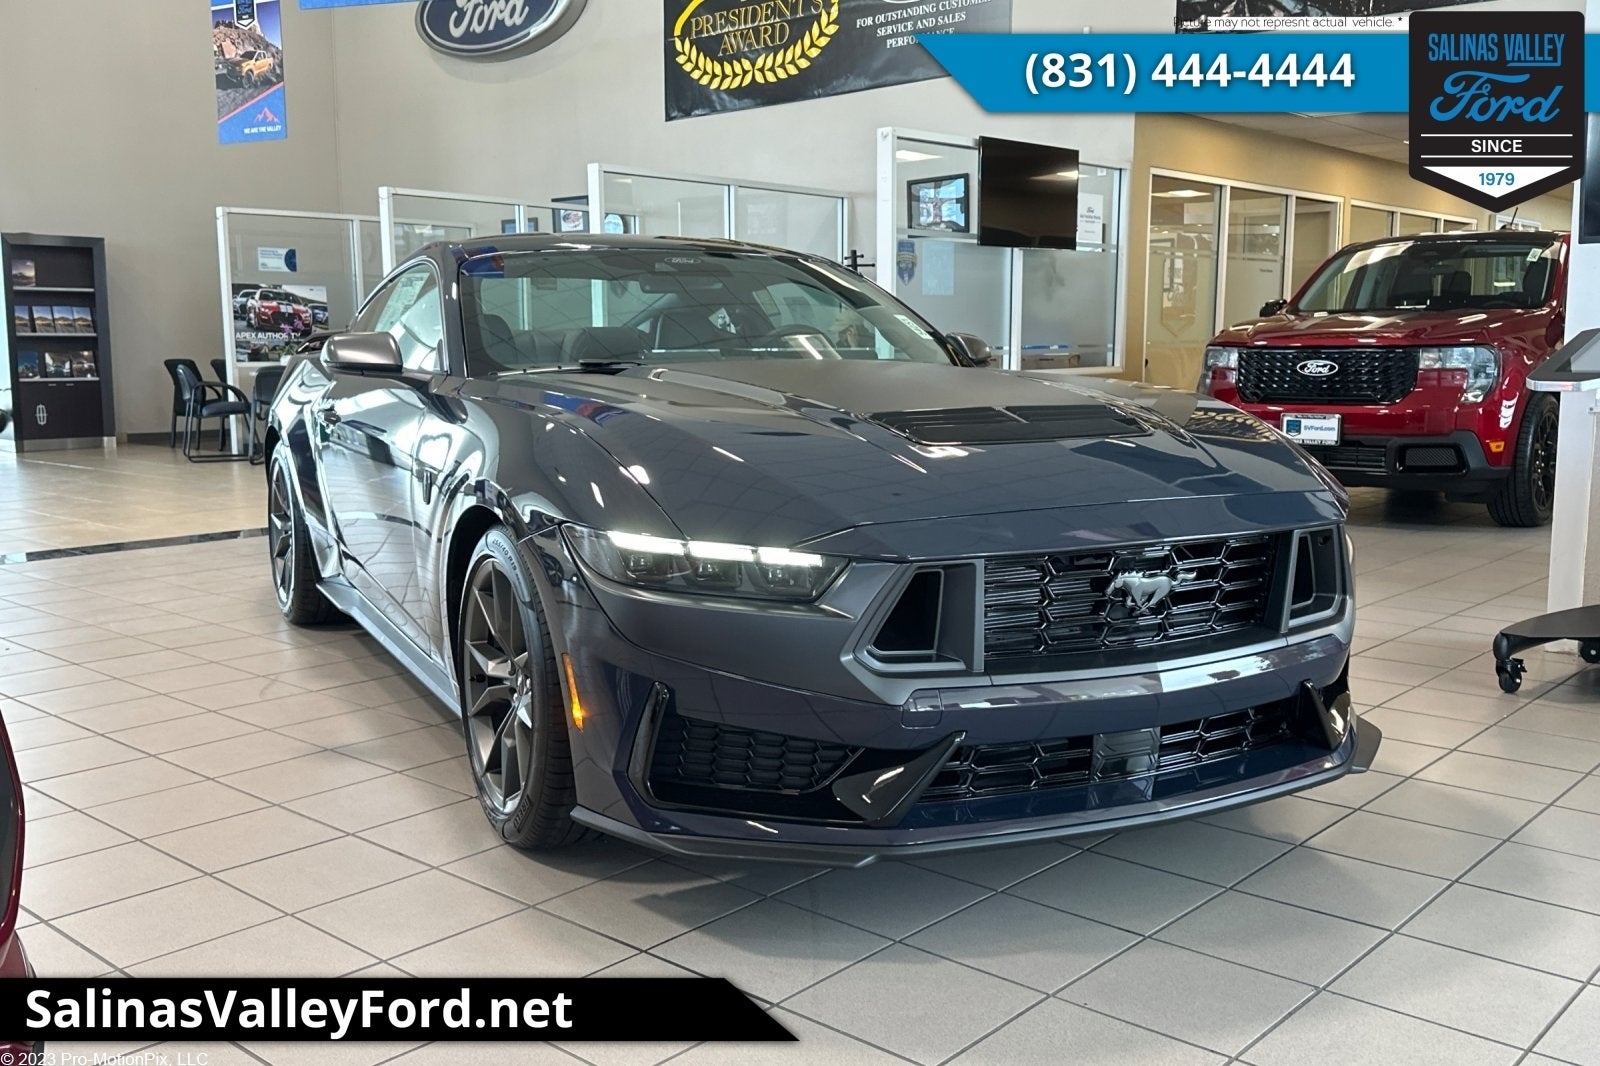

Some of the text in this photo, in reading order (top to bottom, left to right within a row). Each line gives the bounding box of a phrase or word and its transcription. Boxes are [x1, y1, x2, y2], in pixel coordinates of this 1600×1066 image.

[449, 0, 529, 38] Ford
[689, 0, 824, 40] PRESIDENTS
[856, 0, 991, 28] FOR OUTSTANDING CUSTOM
[876, 11, 967, 37] SERVICE AND SALES
[717, 22, 790, 57] AWARD
[267, 124, 282, 132] VALLEY
[235, 331, 301, 341] APEX AUTHORTY
[1304, 360, 1330, 374] Ford
